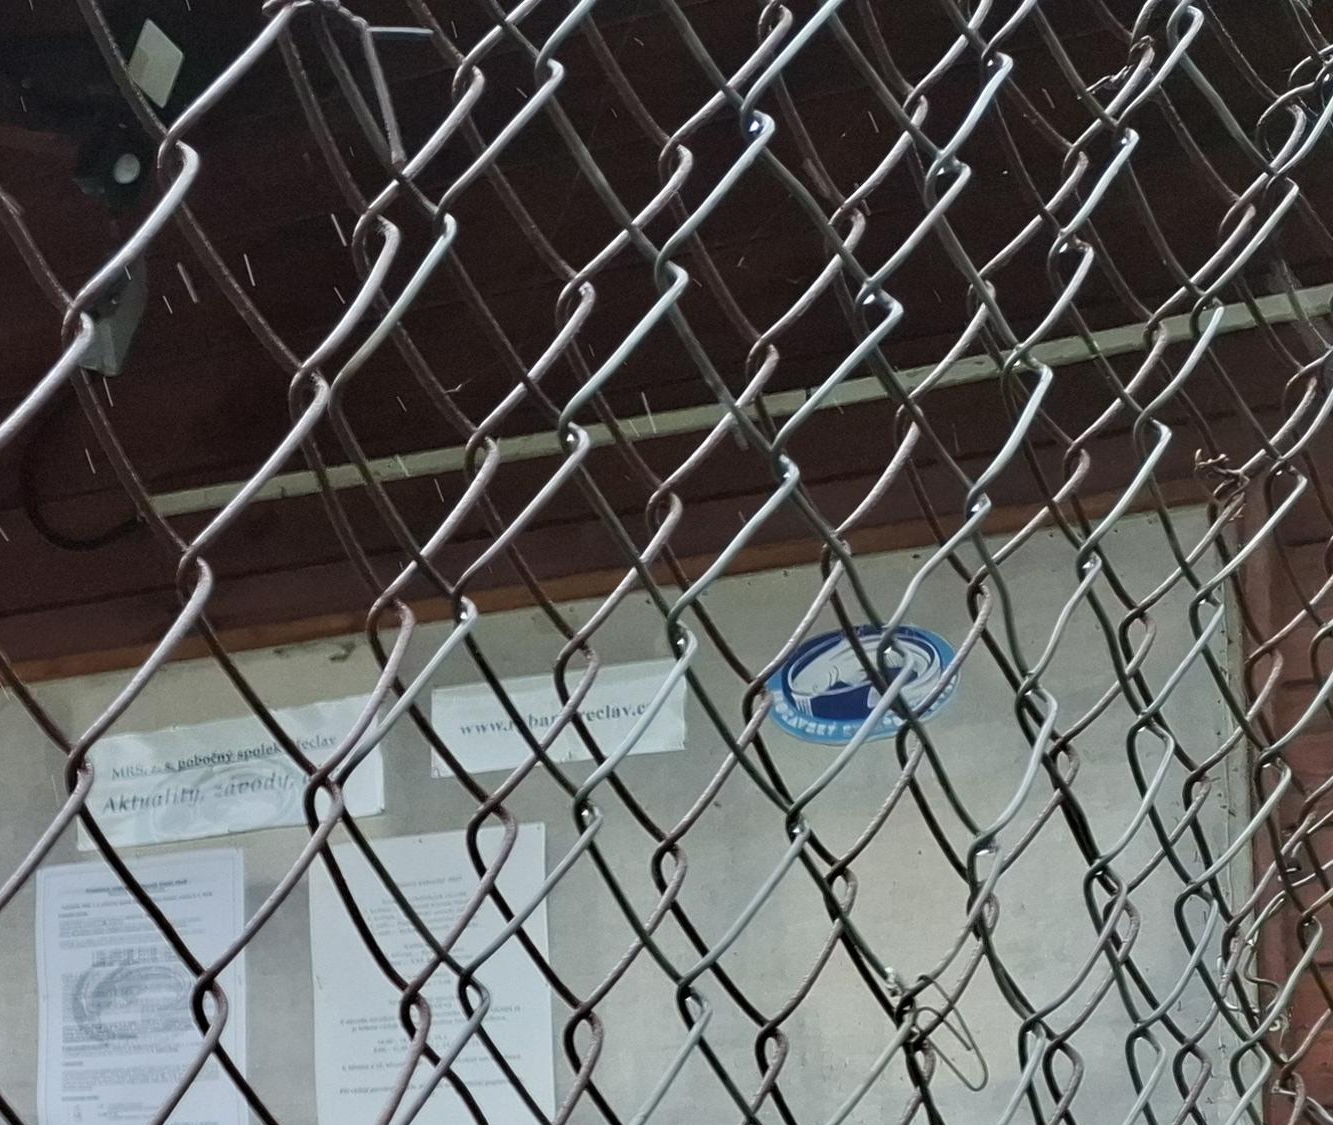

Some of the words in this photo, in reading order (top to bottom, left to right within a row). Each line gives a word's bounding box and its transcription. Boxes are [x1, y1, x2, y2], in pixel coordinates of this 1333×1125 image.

[178, 745, 232, 773] pobočný
[237, 742, 282, 763] spolek
[103, 786, 205, 814] Aktuality,
[214, 772, 294, 798] závody,
